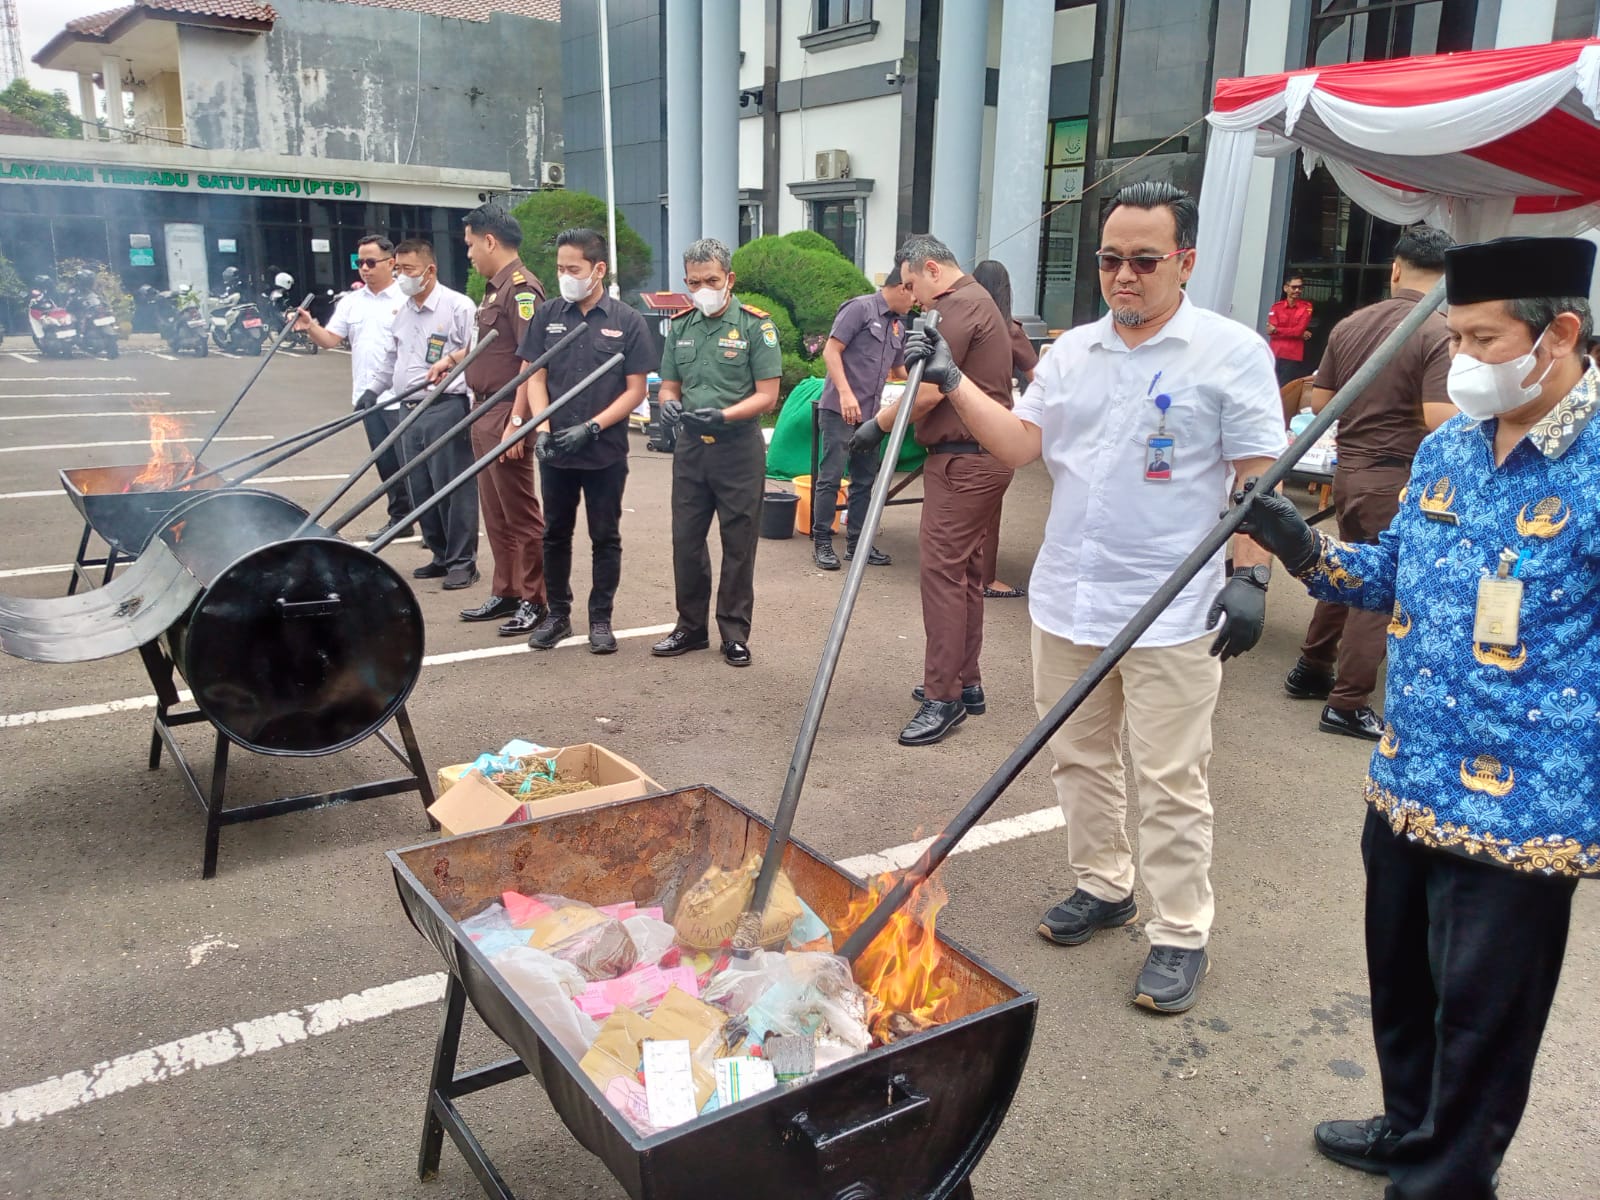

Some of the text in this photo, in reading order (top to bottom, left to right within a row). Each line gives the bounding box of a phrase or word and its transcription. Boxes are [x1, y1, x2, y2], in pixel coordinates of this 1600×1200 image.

[0, 162, 361, 198] LAYANAN TERPADU SATU PINTU (PTSP)
